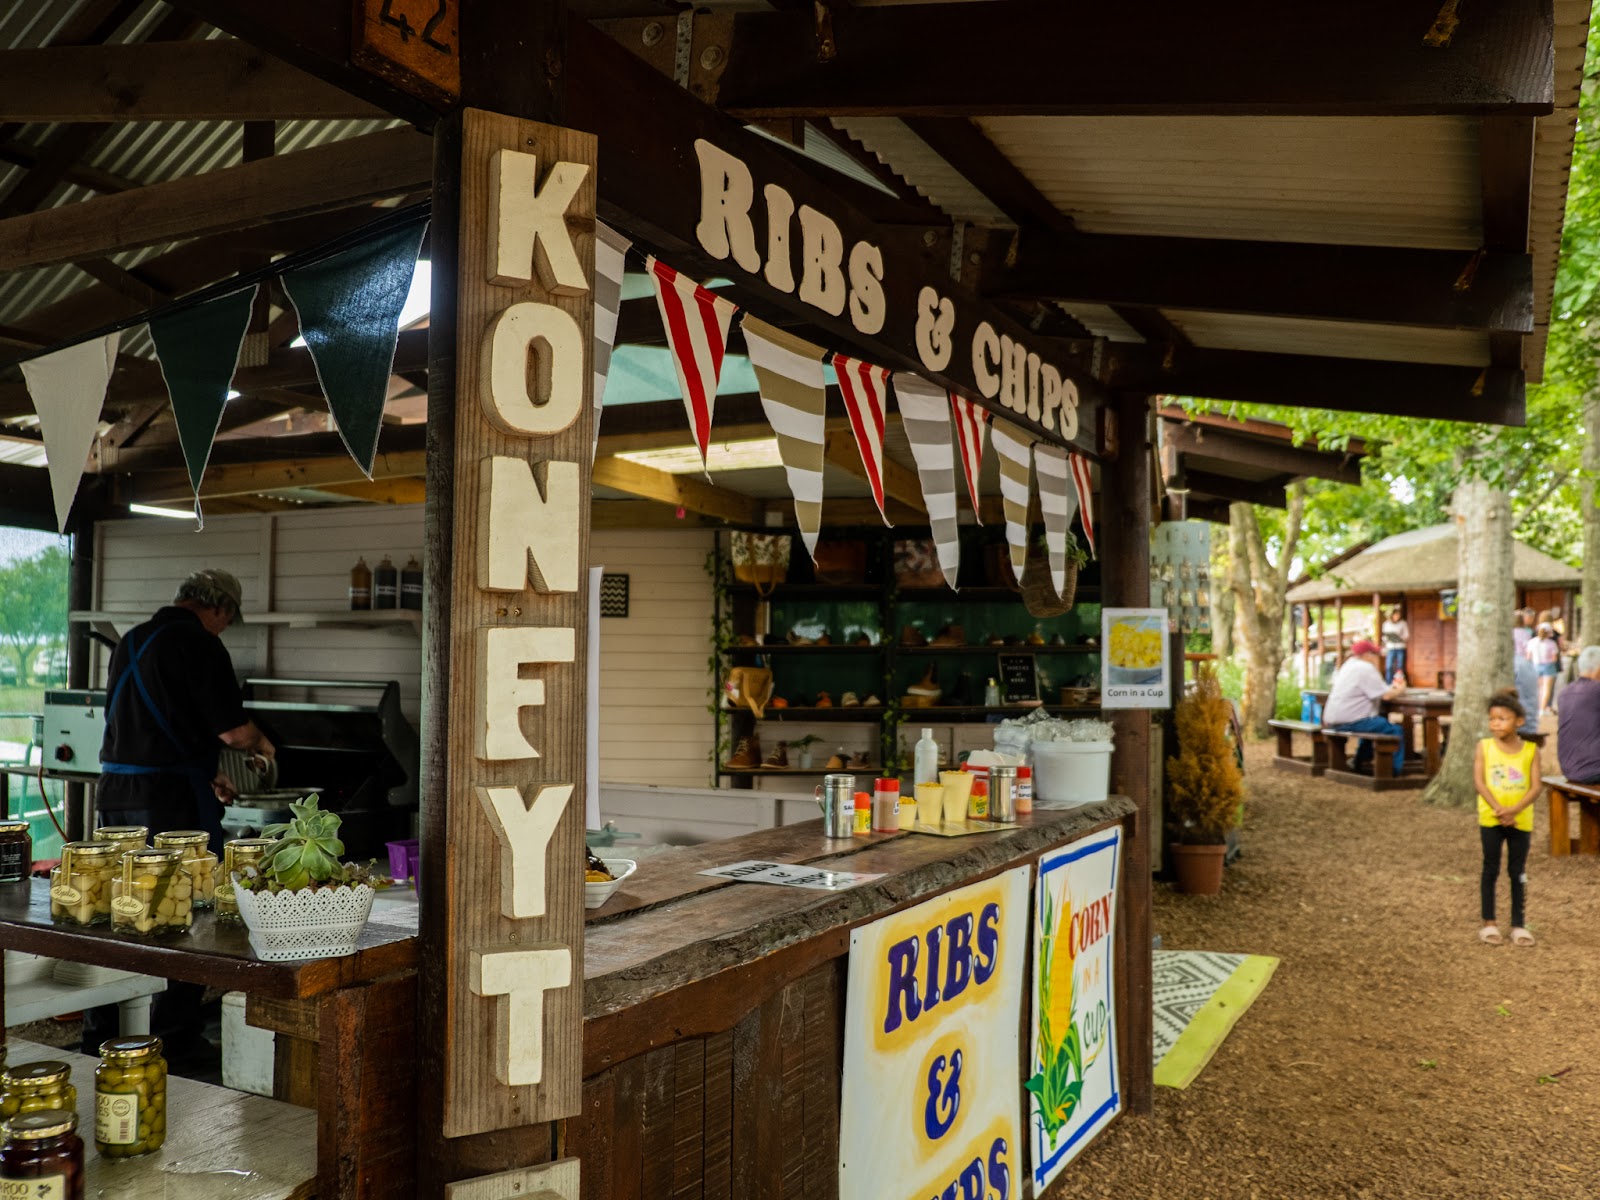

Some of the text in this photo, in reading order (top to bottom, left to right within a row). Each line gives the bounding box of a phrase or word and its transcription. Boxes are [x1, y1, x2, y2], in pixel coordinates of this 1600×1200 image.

[693, 138, 1079, 441] RIBS & CHIPS
[472, 148, 591, 1087] KONFYT
[1107, 688, 1128, 697] Corn
[1130, 688, 1138, 697] in
[1147, 688, 1164, 698] Cup
[1068, 892, 1112, 961] CORN
[883, 902, 1000, 1034] RIBS
[1083, 999, 1106, 1049] CUP
[924, 1048, 962, 1140] &
[0, 1181, 29, 1196] ROO
